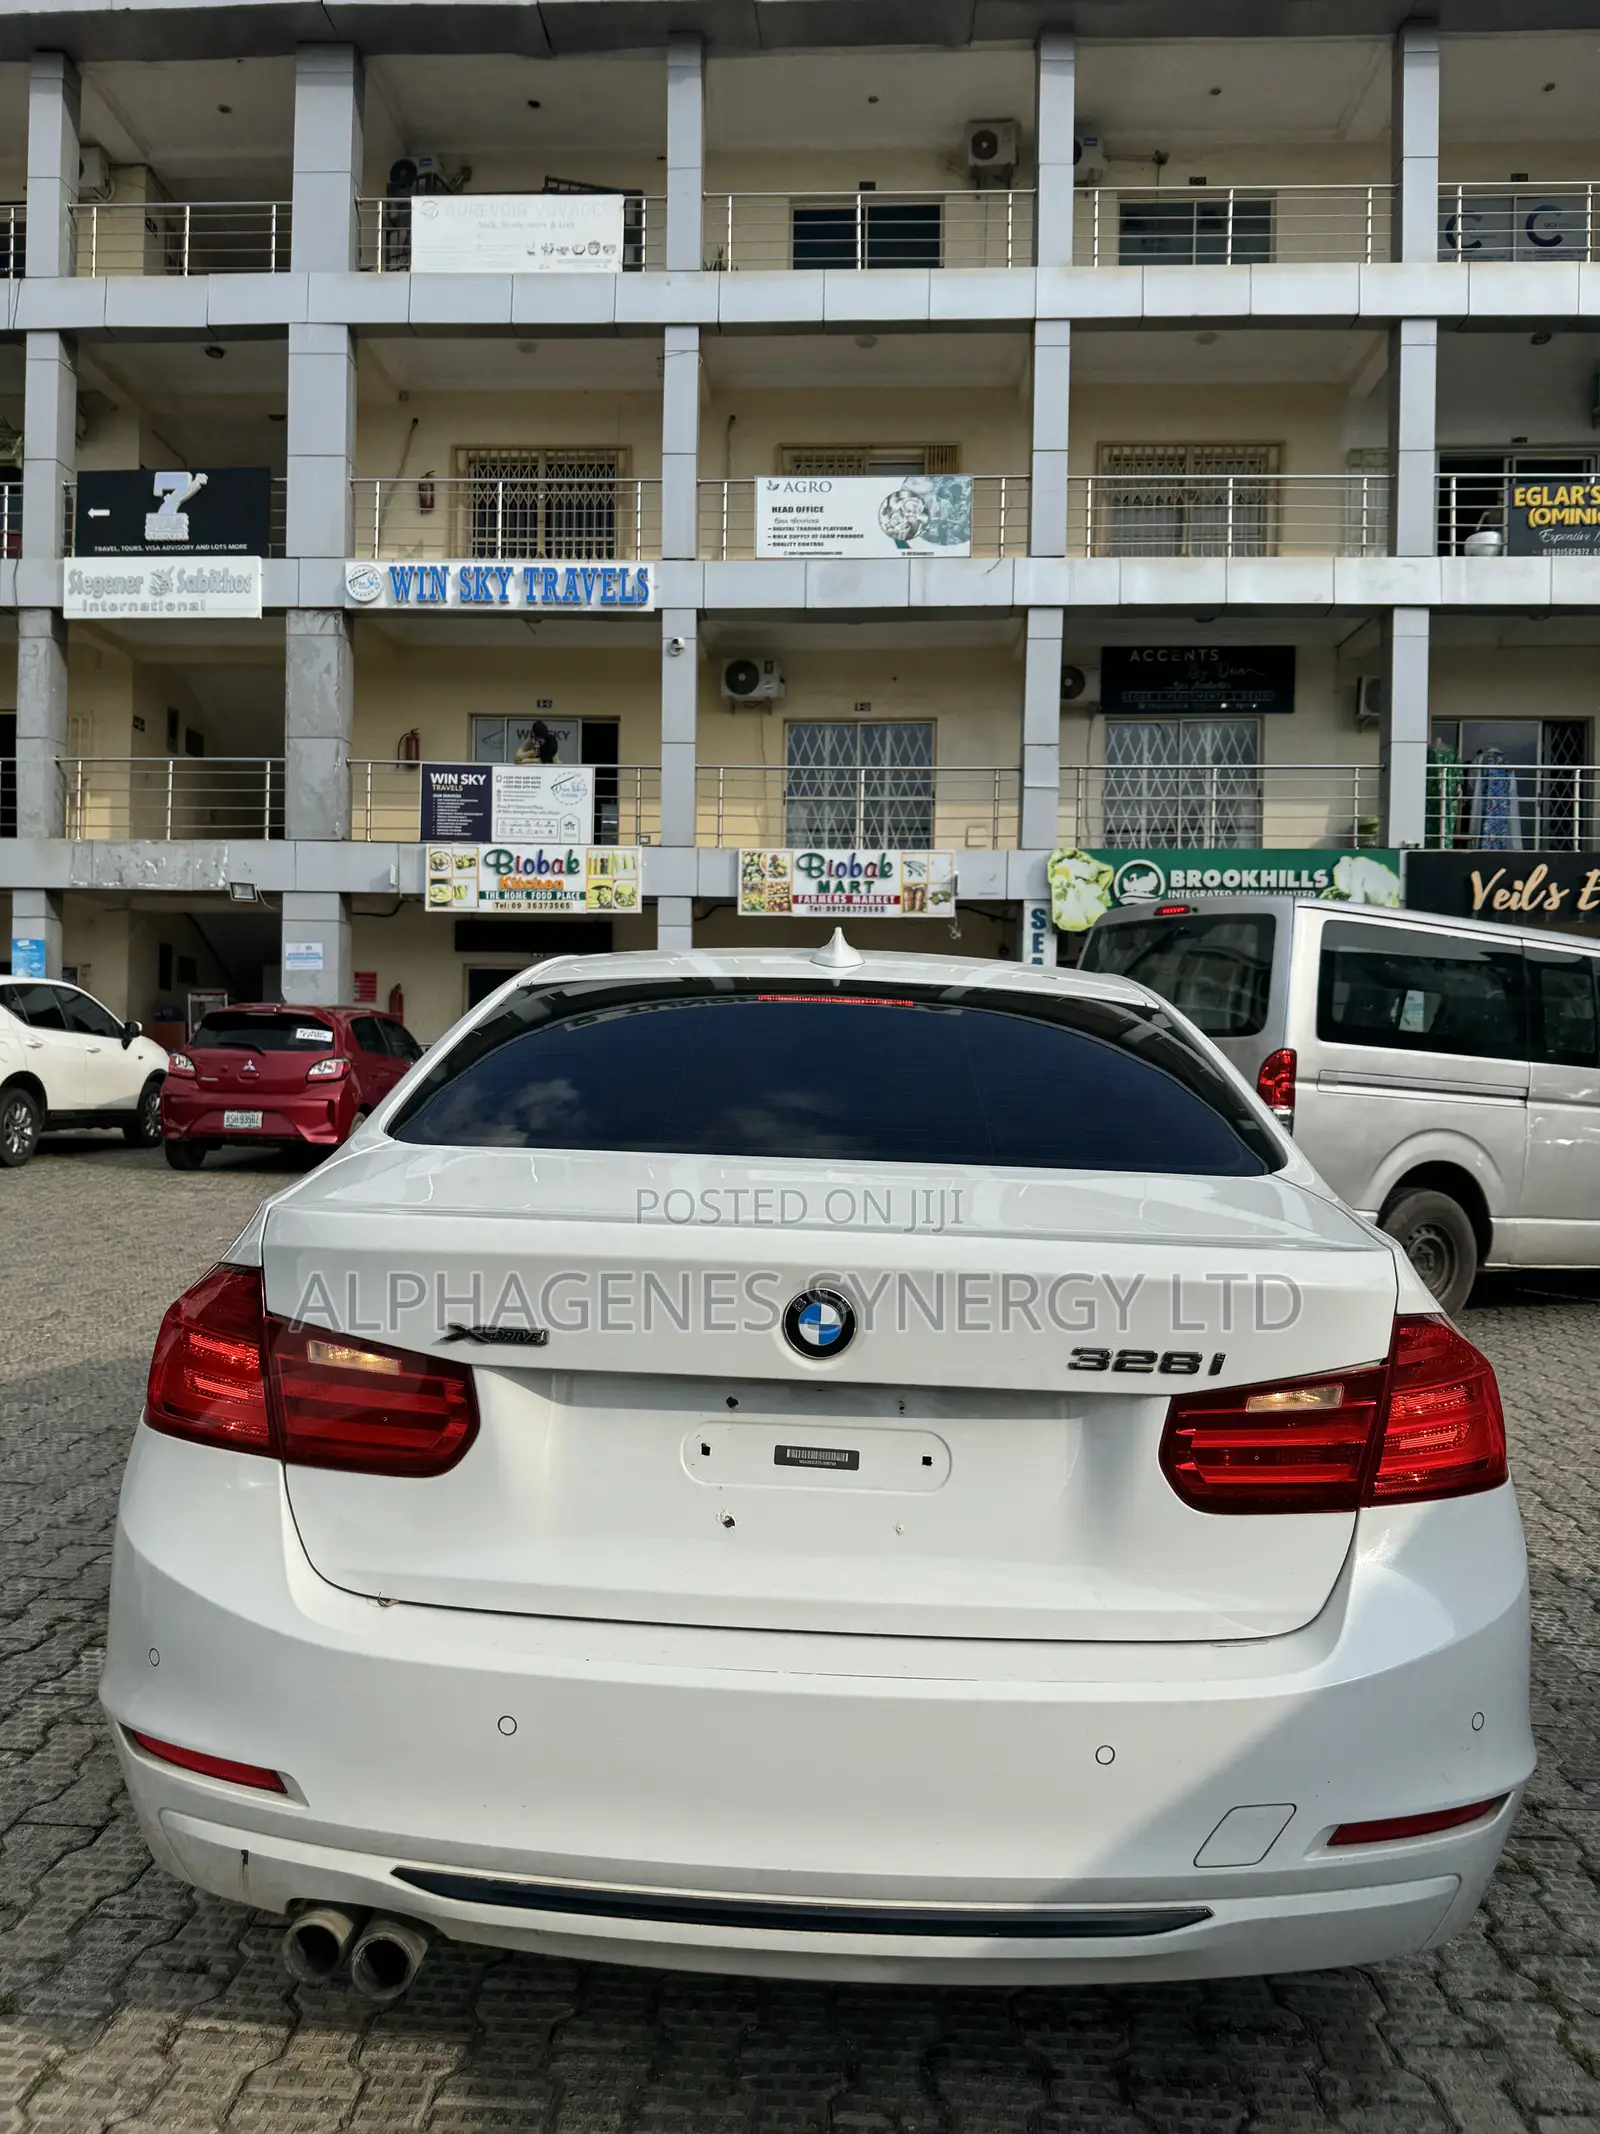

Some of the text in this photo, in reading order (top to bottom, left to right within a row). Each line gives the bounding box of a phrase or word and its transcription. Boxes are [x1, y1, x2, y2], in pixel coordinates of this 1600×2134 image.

[783, 480, 832, 493] AGRO
[771, 506, 824, 514] HEAD OFFICE
[161, 544, 194, 552] ADVISORY
[228, 543, 248, 551] MORE
[68, 567, 252, 598] Siegener Sabithos
[388, 566, 650, 604] WIN SKY TRAVELS
[82, 599, 207, 613] International
[1129, 649, 1220, 662] ACCENTS
[430, 773, 487, 786] WIN SKY
[432, 784, 463, 792] TRAVELS
[484, 848, 580, 876] Biobak
[796, 852, 893, 879] Biobak
[499, 877, 565, 890] Kitchen
[1170, 869, 1329, 889] BROOKHILLS
[817, 880, 875, 894] MART
[485, 891, 581, 900] THE HOME FOOD PLACE
[798, 895, 895, 904] FARMERS MARKET
[1168, 890, 1232, 899] INTEGRATED
